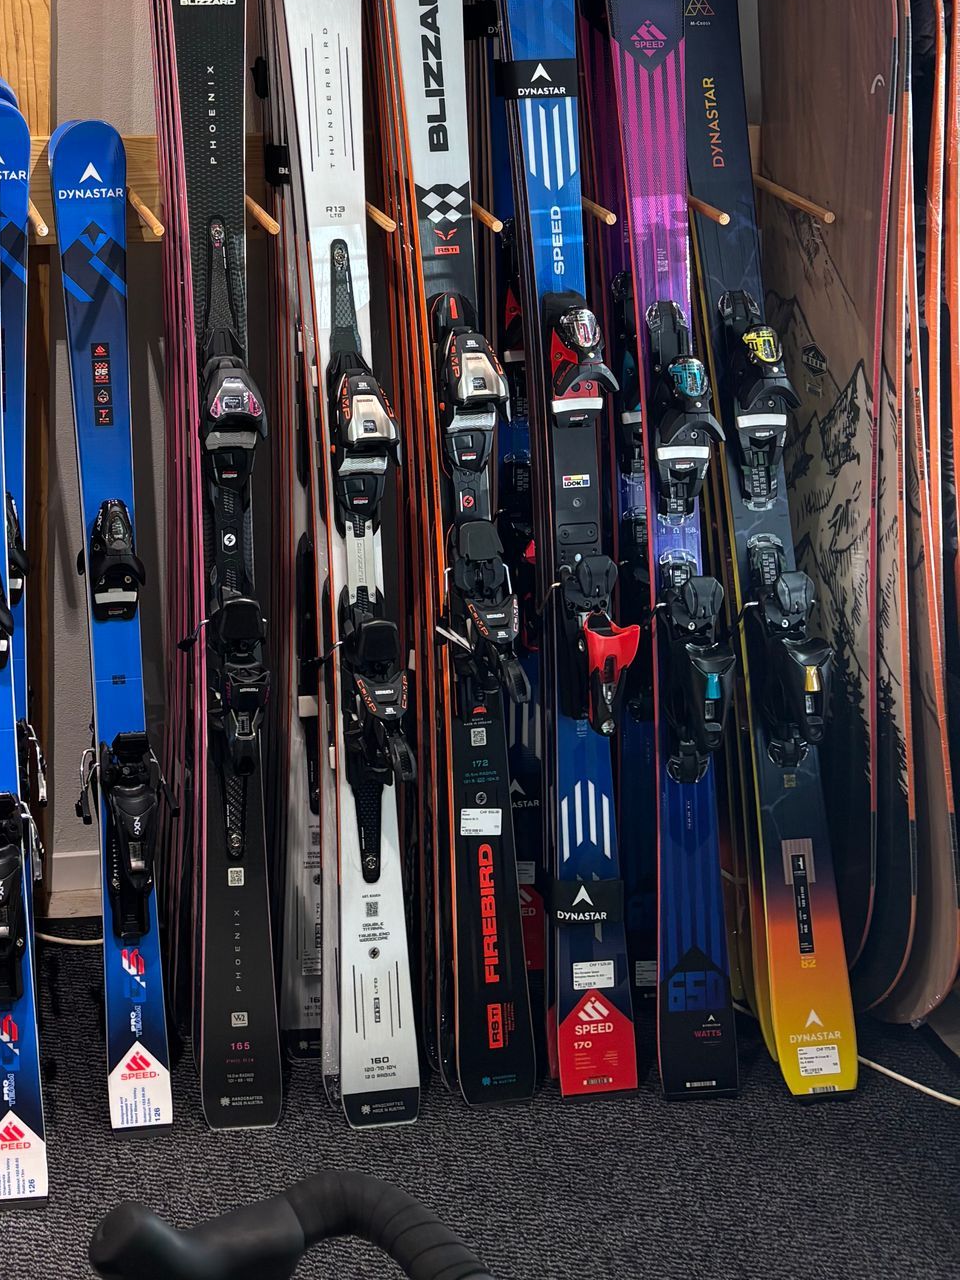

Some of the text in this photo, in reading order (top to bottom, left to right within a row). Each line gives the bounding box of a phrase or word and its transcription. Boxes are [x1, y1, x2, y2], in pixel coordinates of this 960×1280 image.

[634, 40, 665, 49] SPEED
[518, 86, 566, 96] DYNASTAR
[324, 27, 336, 169] THUNDERBIRD
[207, 65, 218, 165] PHOENIX
[702, 76, 725, 168] DYNASTAR
[58, 187, 124, 201] DYNASTAR
[551, 205, 566, 275] SPEED
[511, 799, 540, 809] ASTAR
[478, 843, 500, 984] FIREBIRD
[557, 911, 607, 921] DYNASTAR
[234, 910, 242, 992] PHOENIX
[134, 1005, 142, 1037] TEAM
[575, 1023, 614, 1035] SPEED
[790, 1031, 841, 1043] DYNASTAR
[231, 1042, 250, 1050] 165
[574, 1041, 592, 1049] 170
[371, 1057, 390, 1065] 160
[121, 1071, 157, 1081] SPEED
[7, 1073, 16, 1107] TEAM
